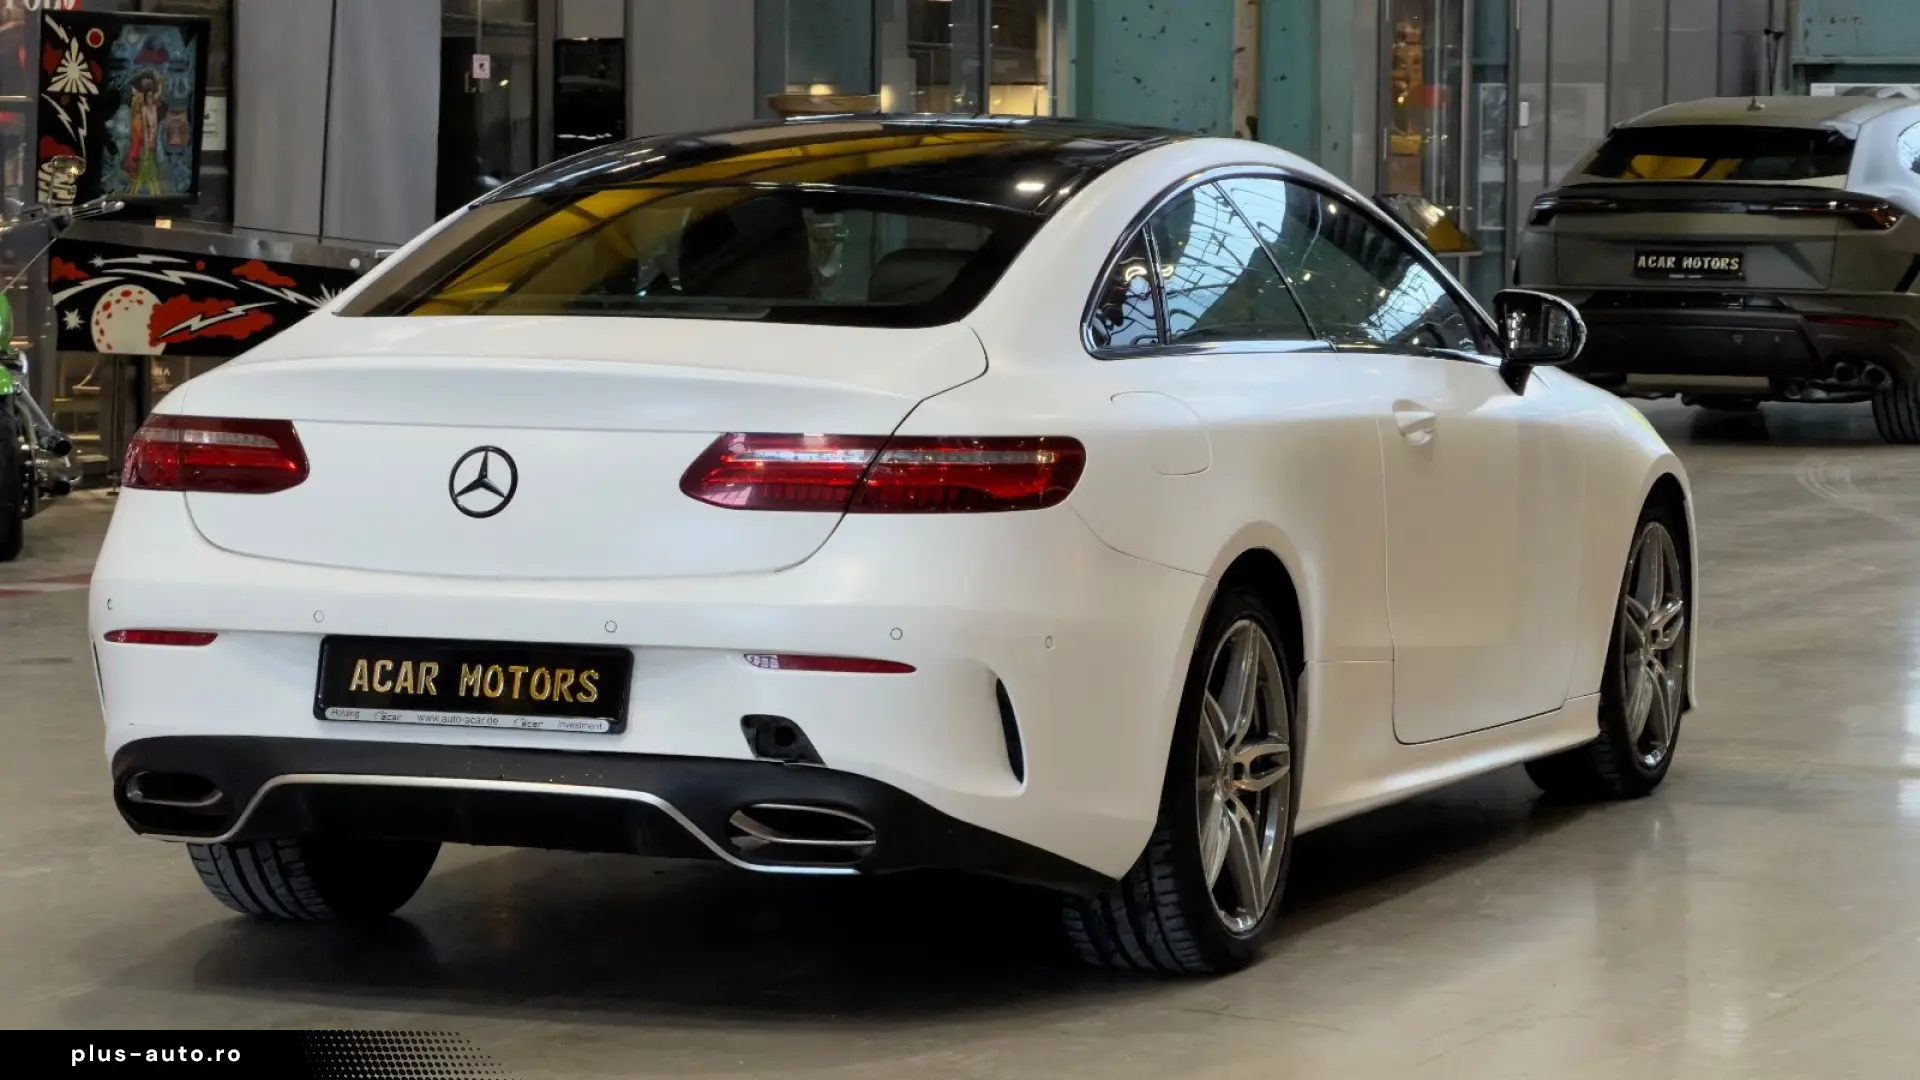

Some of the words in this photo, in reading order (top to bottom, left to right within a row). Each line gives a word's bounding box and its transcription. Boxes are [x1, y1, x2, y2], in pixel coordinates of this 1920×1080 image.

[1637, 255, 1676, 269] ACAR
[1682, 256, 1740, 270] MOTORS
[350, 659, 439, 695] ACAR
[458, 663, 599, 702] MOTORS
[417, 713, 499, 726] www.auto-acar.de
